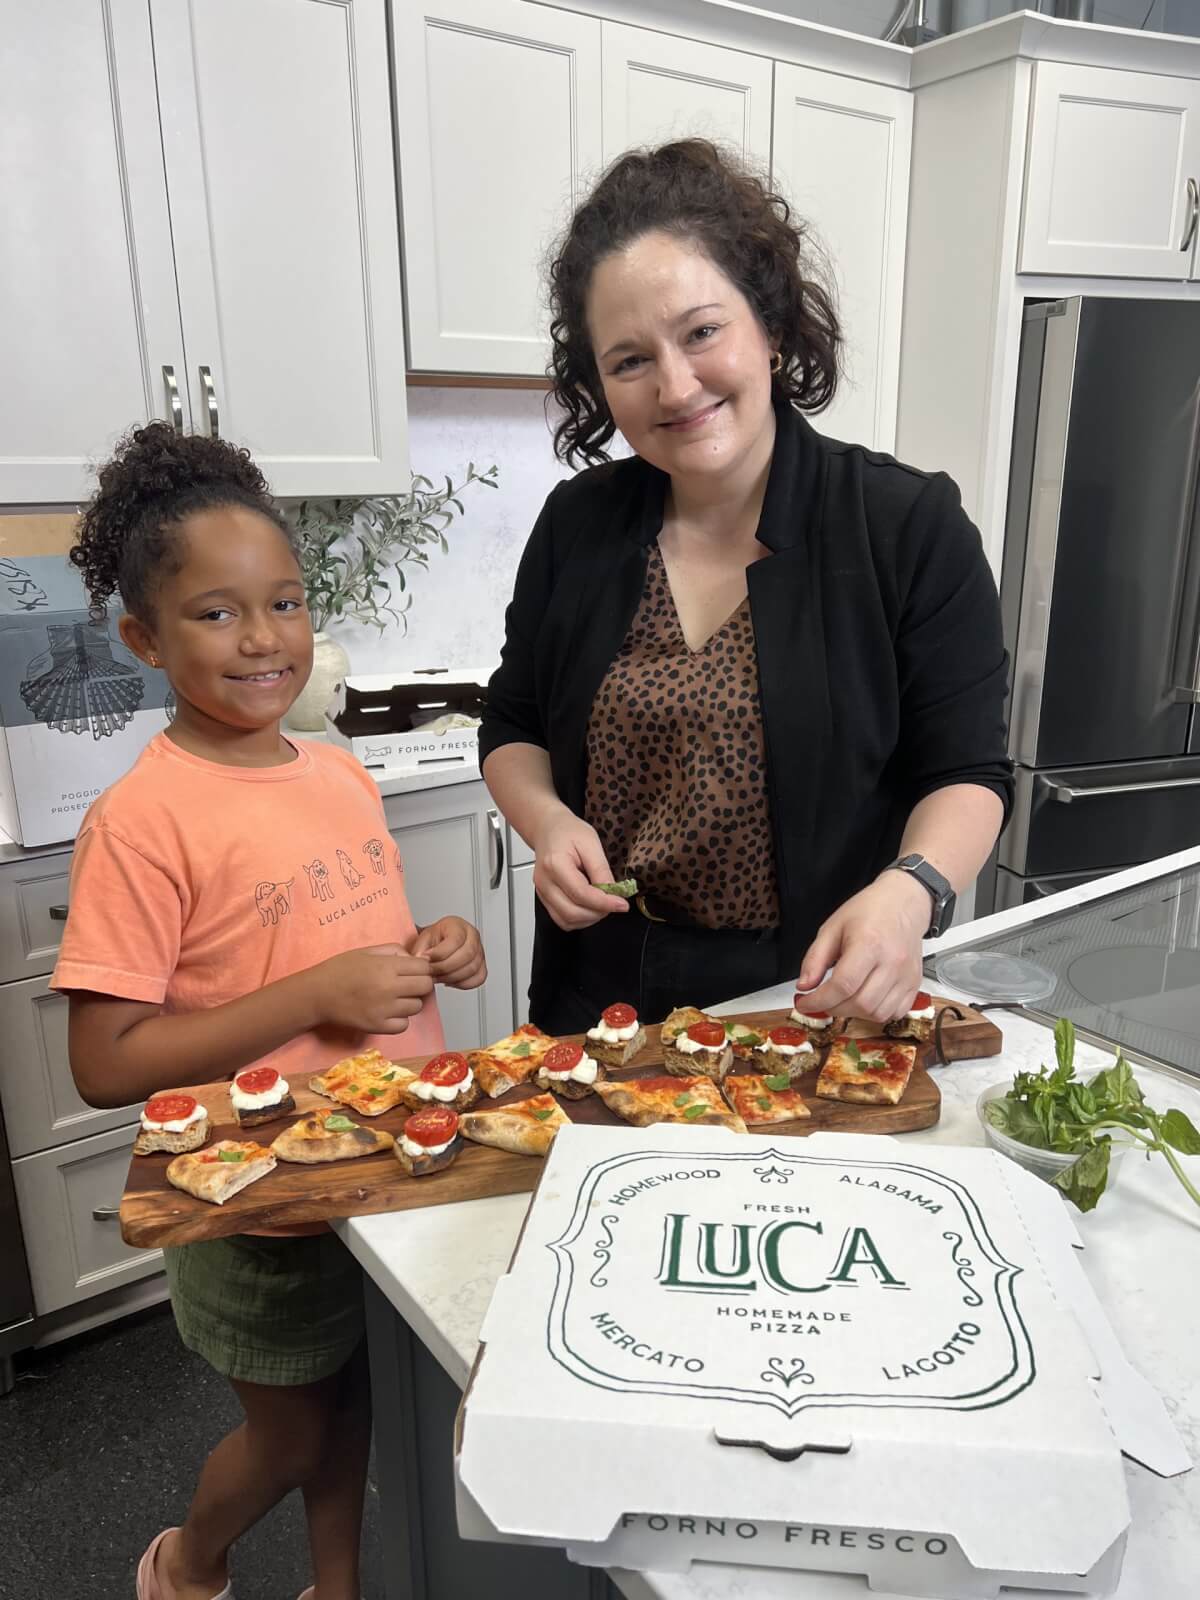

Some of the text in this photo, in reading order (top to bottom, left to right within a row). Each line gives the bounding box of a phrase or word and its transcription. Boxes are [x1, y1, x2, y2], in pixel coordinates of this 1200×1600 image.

[398, 740, 479, 754] FORNO FRESC
[61, 788, 101, 800] POGGIO
[318, 887, 389, 926] LUCA LAGOTTO
[608, 1168, 722, 1207] HOMEWOOD
[839, 1174, 944, 1215] ALABAMA
[743, 1203, 811, 1214] FRESH
[654, 1212, 911, 1297] LUCA
[717, 1306, 852, 1323] HOMEMADE
[750, 1321, 822, 1336] PIZZA
[590, 1312, 705, 1374] MERCATO
[881, 1321, 982, 1382] LAGOTTO
[621, 1513, 949, 1556] FORNO FRESCO
